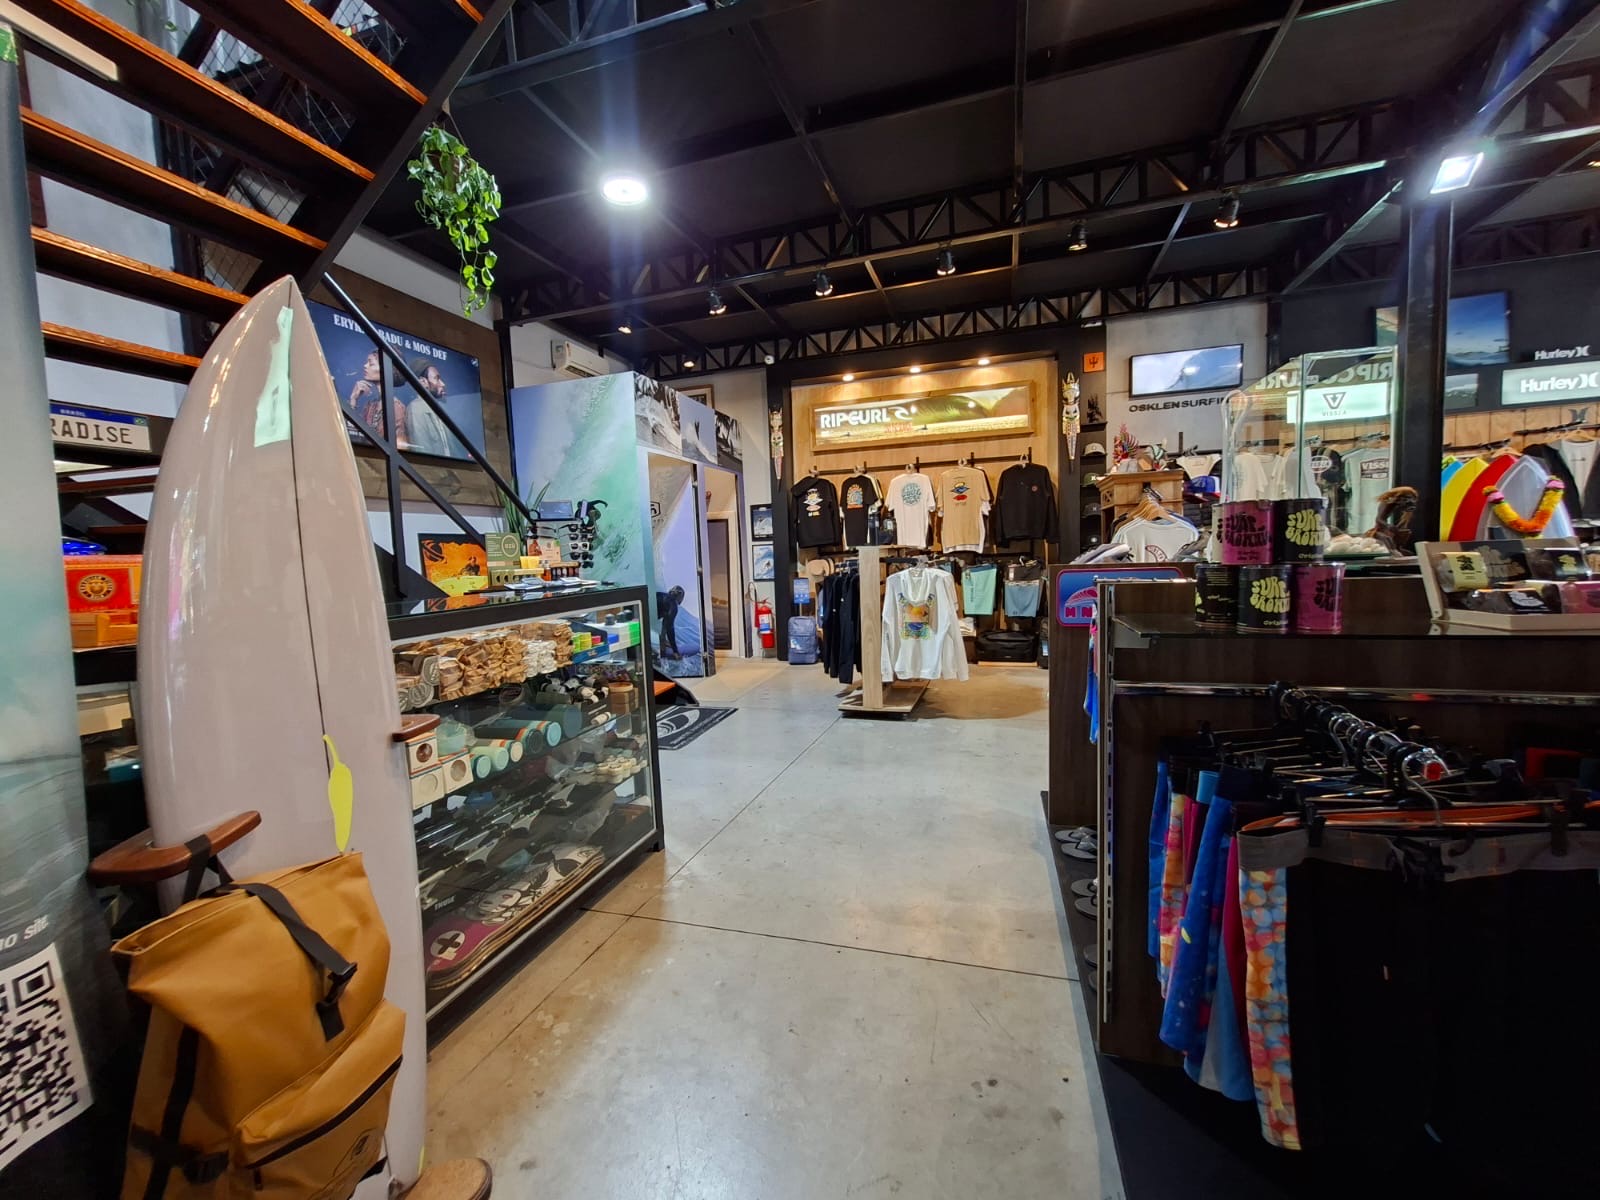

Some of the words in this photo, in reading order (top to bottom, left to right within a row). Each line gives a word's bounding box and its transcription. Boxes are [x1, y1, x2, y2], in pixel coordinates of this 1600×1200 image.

[333, 313, 365, 335] ERYK
[404, 339, 412, 349] &
[412, 341, 431, 356] MOS
[432, 348, 448, 361] DEF
[1534, 348, 1576, 360] Hurley
[1520, 376, 1579, 393] Hurley
[1181, 397, 1231, 408] SURFIN
